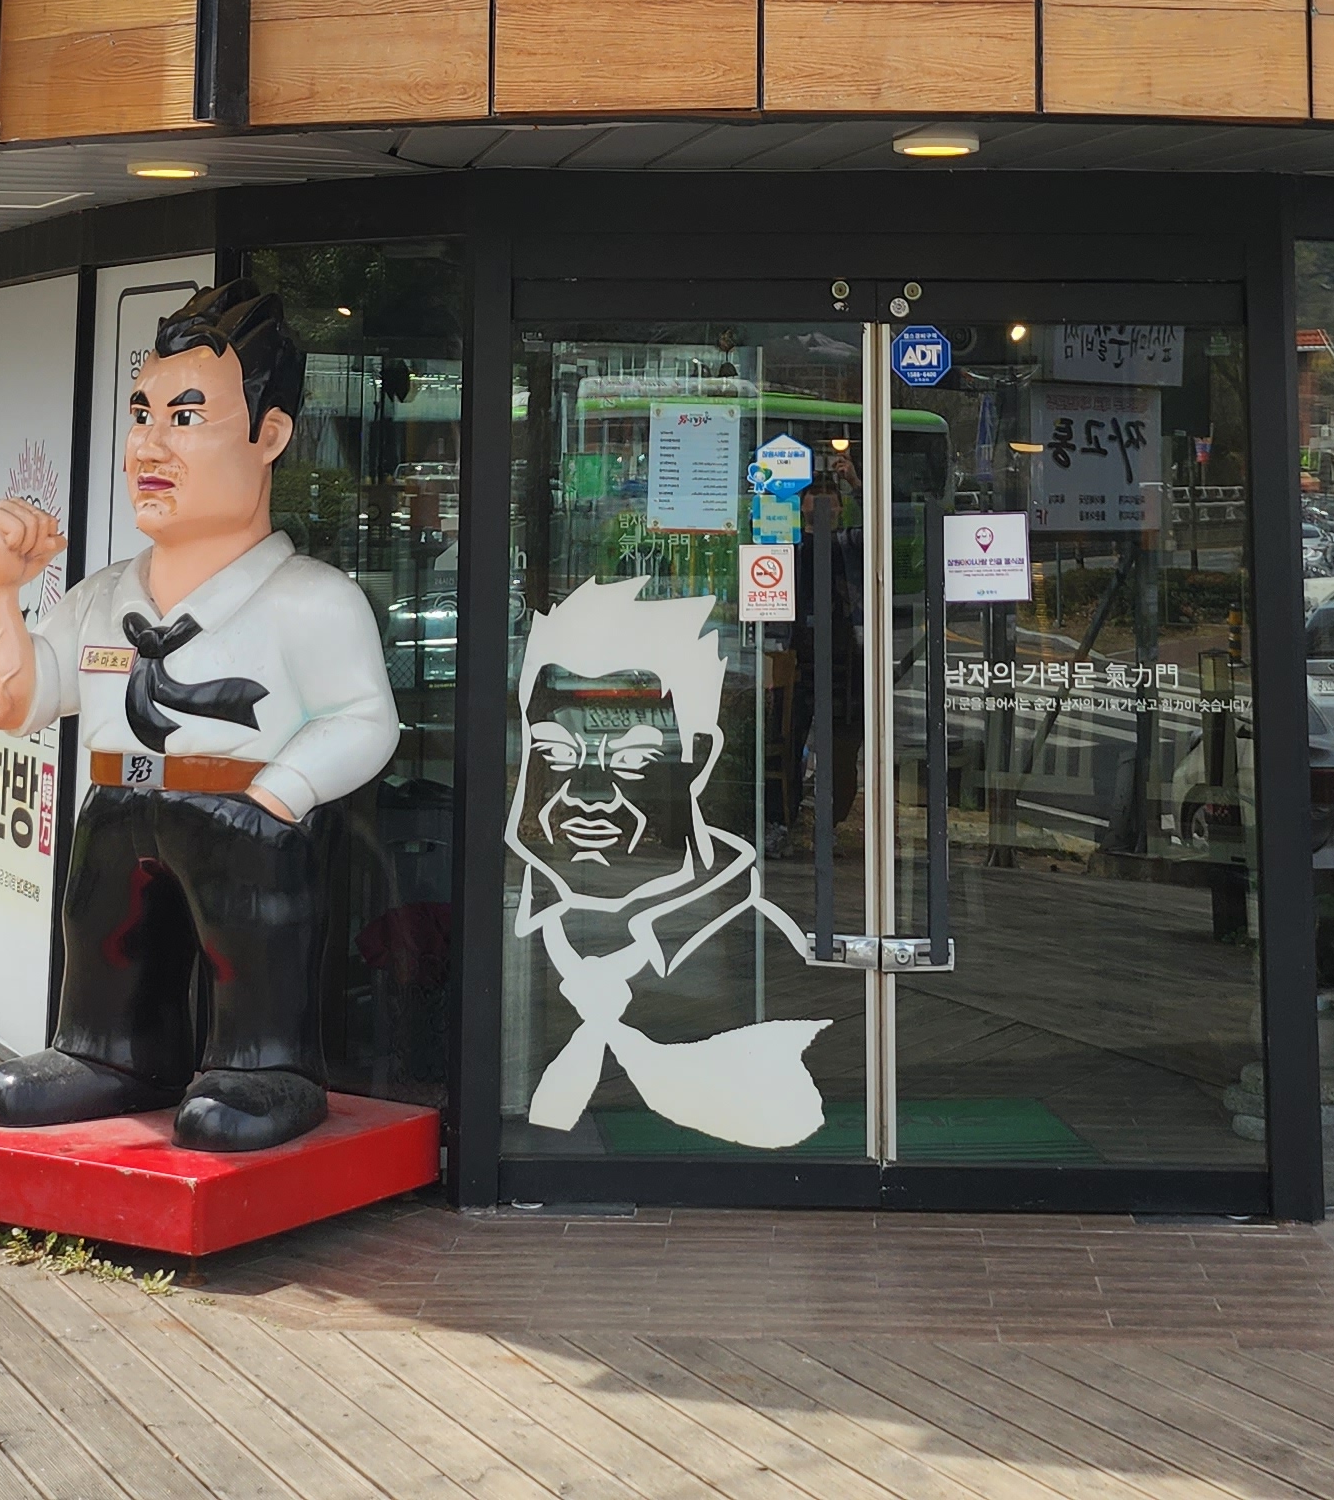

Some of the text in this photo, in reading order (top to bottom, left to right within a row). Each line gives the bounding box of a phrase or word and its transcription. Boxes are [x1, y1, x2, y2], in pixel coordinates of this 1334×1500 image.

[900, 344, 942, 367] ADT
[619, 533, 691, 562] 氣力門
[747, 590, 788, 602] 금연구역
[100, 655, 130, 668] 마초리
[944, 660, 1179, 689] 남자의 기력문 氣力門
[983, 697, 1031, 712] 들어서는
[1033, 697, 1057, 711] 순간
[1060, 697, 1095, 712] 남자의
[1135, 697, 1159, 711] 살고
